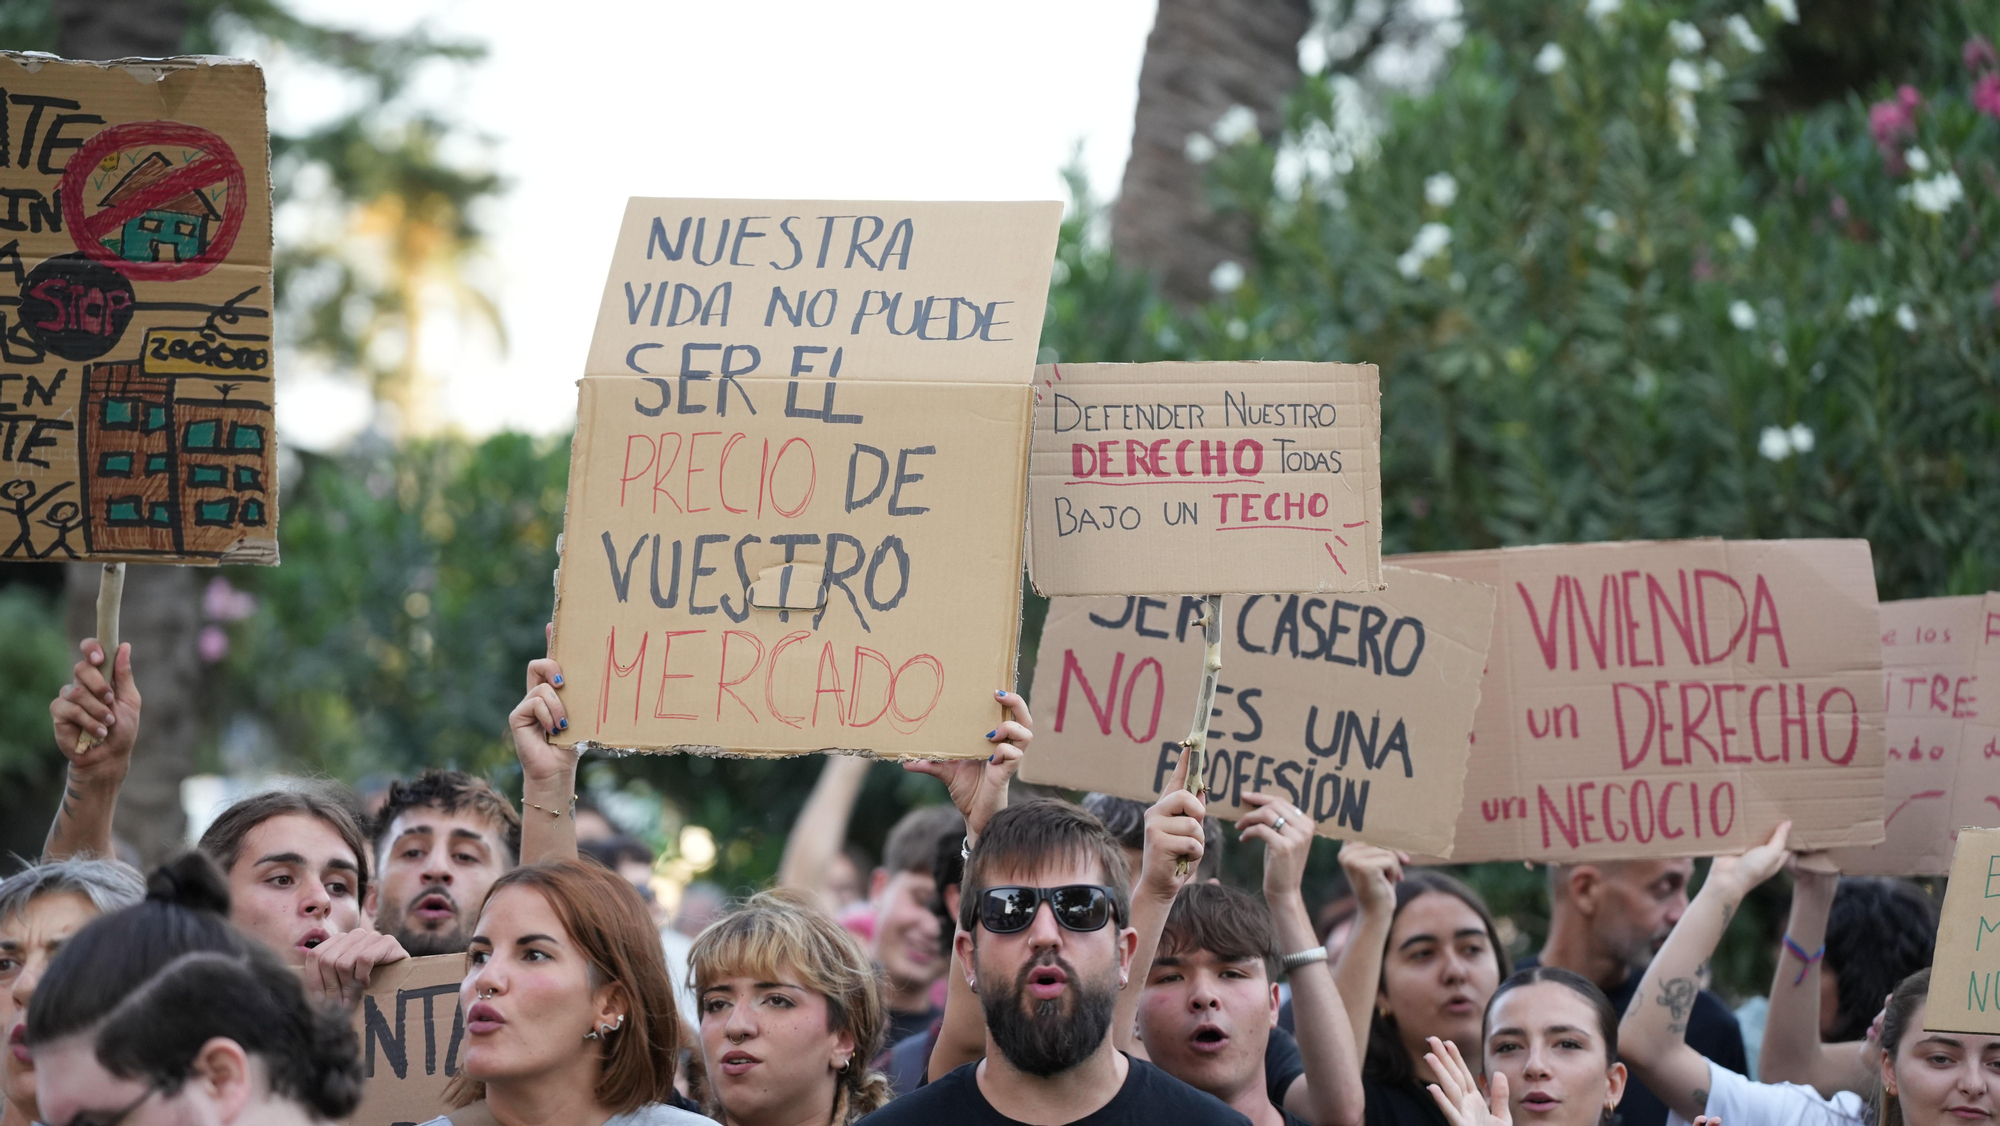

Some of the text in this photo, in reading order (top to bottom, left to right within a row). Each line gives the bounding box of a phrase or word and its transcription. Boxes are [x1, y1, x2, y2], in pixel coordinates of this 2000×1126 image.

[646, 215, 914, 271] NUESTRA
[30, 278, 132, 336] STOP
[624, 281, 1015, 341] VIDA NO PUEDE
[625, 343, 864, 425] SER EL
[620, 431, 937, 519] PRECIO DE
[1071, 438, 1264, 478] DERECHO
[1212, 492, 1329, 524] TECHO
[601, 530, 911, 633] VUESTRO
[1516, 569, 1790, 672] VIVIENDA
[1236, 594, 1426, 678] CASERO
[596, 626, 945, 735] MERCADO
[1054, 648, 1164, 744] NO
[1305, 705, 1414, 778] UNA
[1527, 680, 1860, 771] un DERECHO
[1482, 778, 1735, 850] un NEGOCIO
